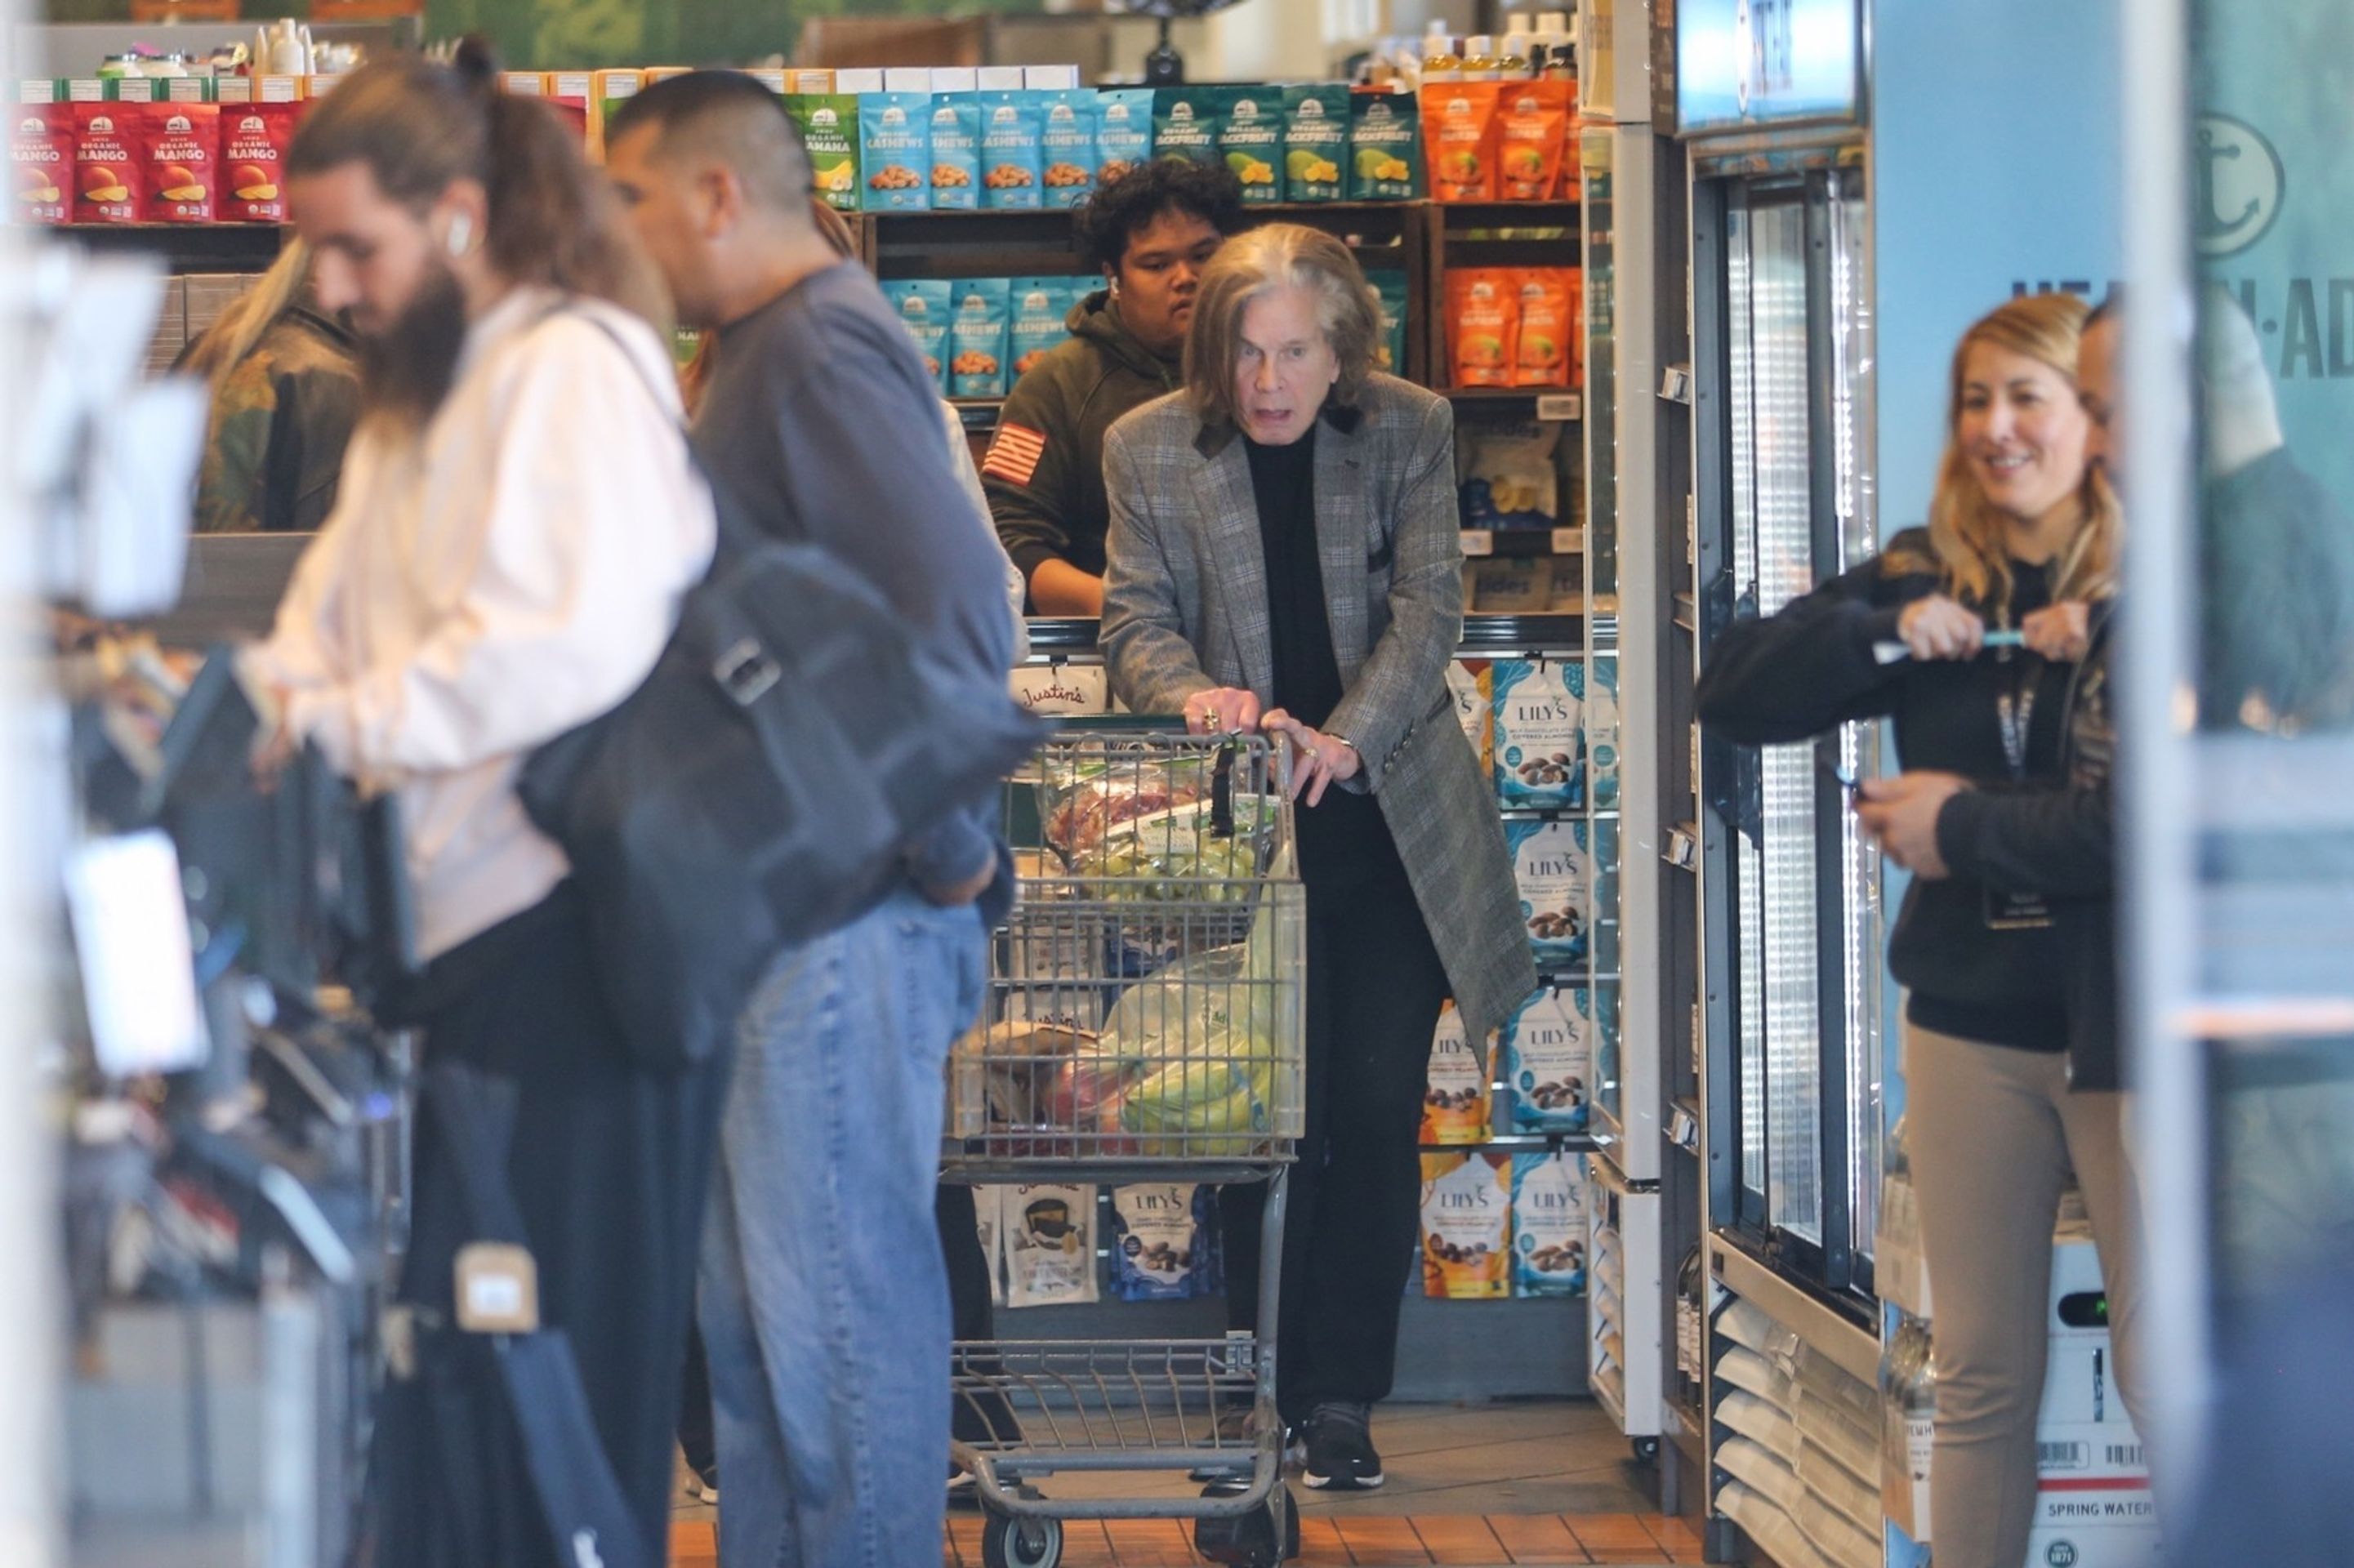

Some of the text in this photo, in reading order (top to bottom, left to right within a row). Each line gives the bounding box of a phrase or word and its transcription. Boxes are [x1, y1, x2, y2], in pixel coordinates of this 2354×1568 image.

[867, 136, 924, 149] CASHEWS
[932, 136, 973, 148] SHEWS
[983, 136, 1035, 147] ASHEWS
[1042, 134, 1090, 146] ASHEWS
[1155, 134, 1211, 145] ACKFRUIT
[1219, 133, 1277, 145] ACKFRUIT
[1284, 132, 1344, 144] ACKFRUIT
[1352, 131, 1412, 143] ACKFRUIT
[805, 141, 851, 153] ANANA
[78, 150, 127, 162] MANGO
[154, 149, 204, 161] MANGO
[227, 149, 278, 160] MANGO
[1022, 684, 1085, 708] Justin's
[2049, 1502, 2152, 1517] SPRING WATER
